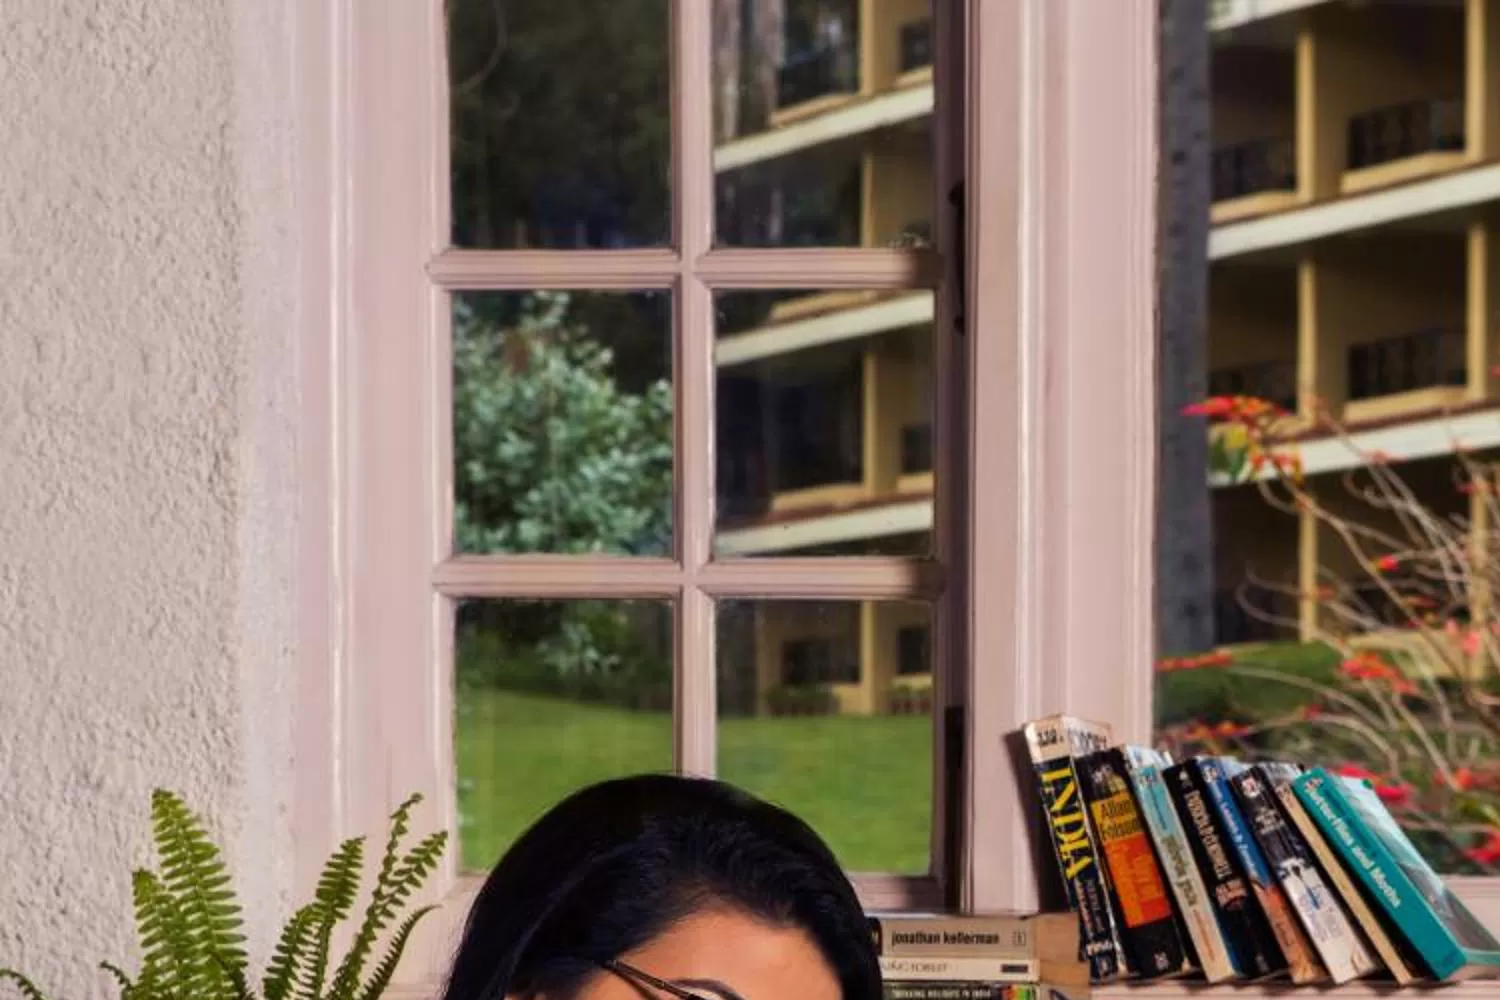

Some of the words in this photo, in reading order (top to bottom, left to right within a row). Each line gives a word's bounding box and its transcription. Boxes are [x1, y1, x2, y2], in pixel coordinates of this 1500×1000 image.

[1040, 767, 1094, 879] INDIA
[1352, 842, 1375, 868] and
[1371, 866, 1403, 908] Moths
[891, 930, 940, 946] jonathan
[944, 930, 999, 945] kellerman
